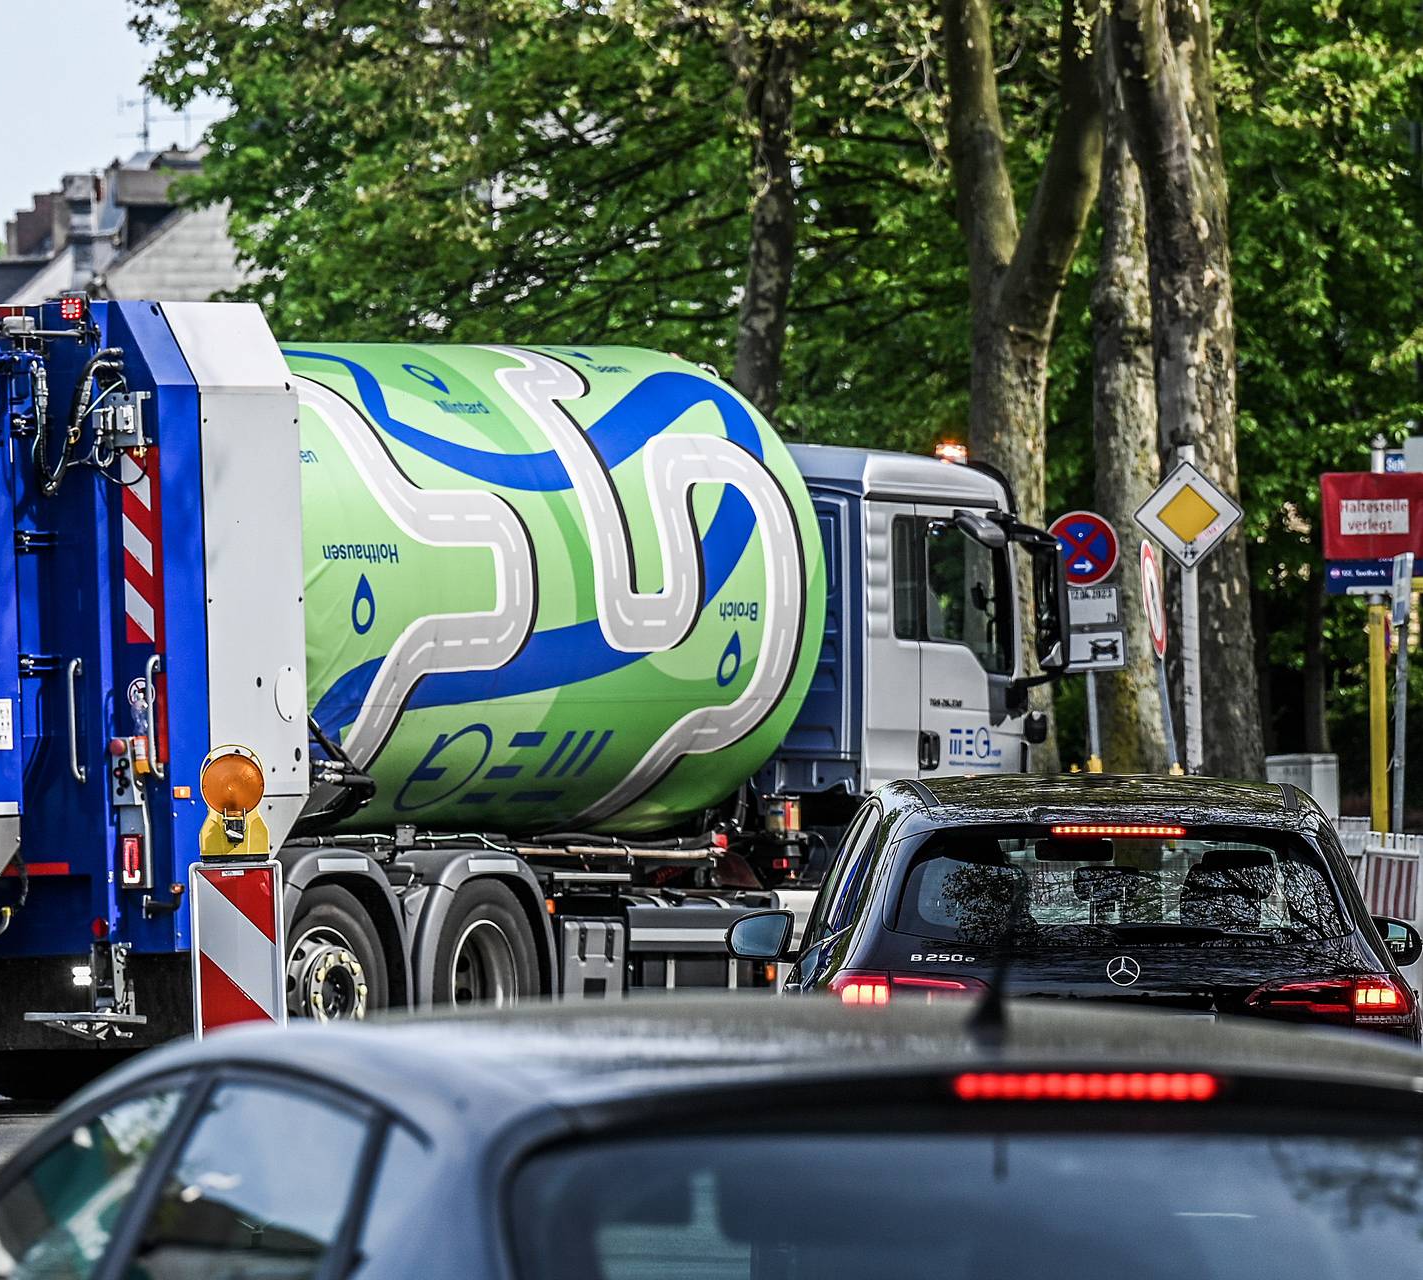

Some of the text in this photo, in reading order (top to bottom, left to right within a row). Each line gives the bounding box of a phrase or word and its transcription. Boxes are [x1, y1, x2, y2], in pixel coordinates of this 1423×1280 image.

[435, 400, 489, 414] Mintard
[1341, 502, 1407, 513] Haltestelle
[1347, 520, 1392, 532] verlegt
[322, 543, 399, 563] Holthausen
[719, 602, 758, 621] Broich
[949, 727, 989, 758] MEG
[925, 954, 963, 962] 250
